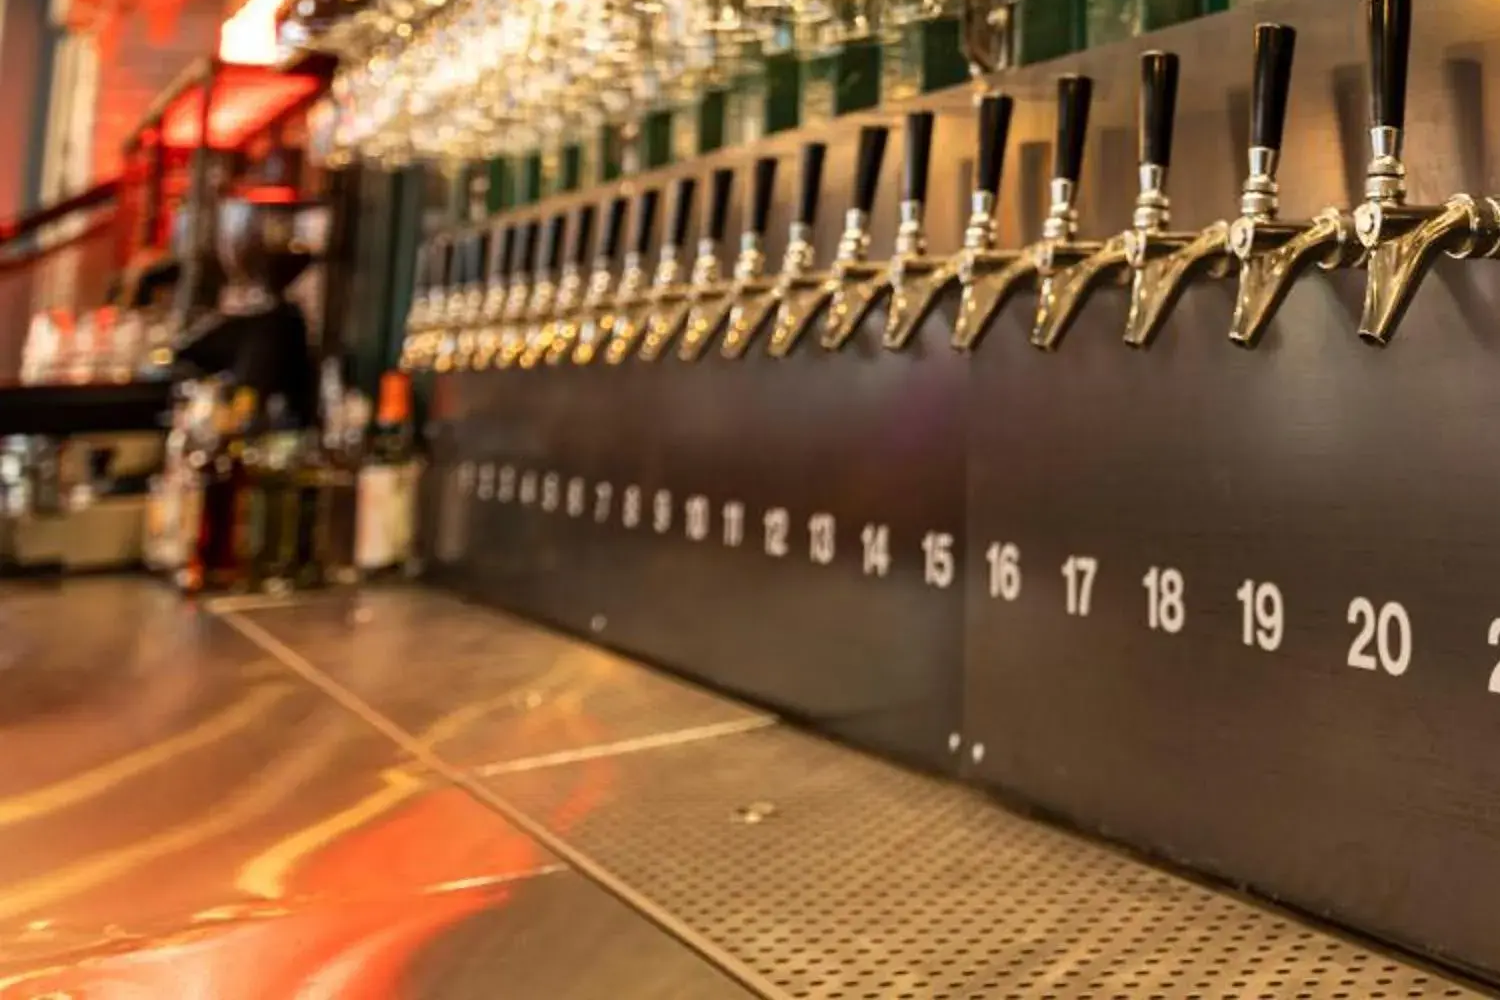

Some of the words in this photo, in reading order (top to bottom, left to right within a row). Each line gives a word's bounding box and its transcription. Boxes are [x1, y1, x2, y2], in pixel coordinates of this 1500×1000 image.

[722, 502, 745, 547] 11
[763, 507, 789, 557] 12
[808, 513, 835, 565] 13
[862, 525, 889, 577] 14
[921, 532, 954, 588] 15
[986, 543, 1021, 601] 16
[1062, 556, 1097, 616] 17
[1143, 567, 1184, 632] 18
[1237, 580, 1284, 651] 19
[1347, 597, 1412, 676] 20
